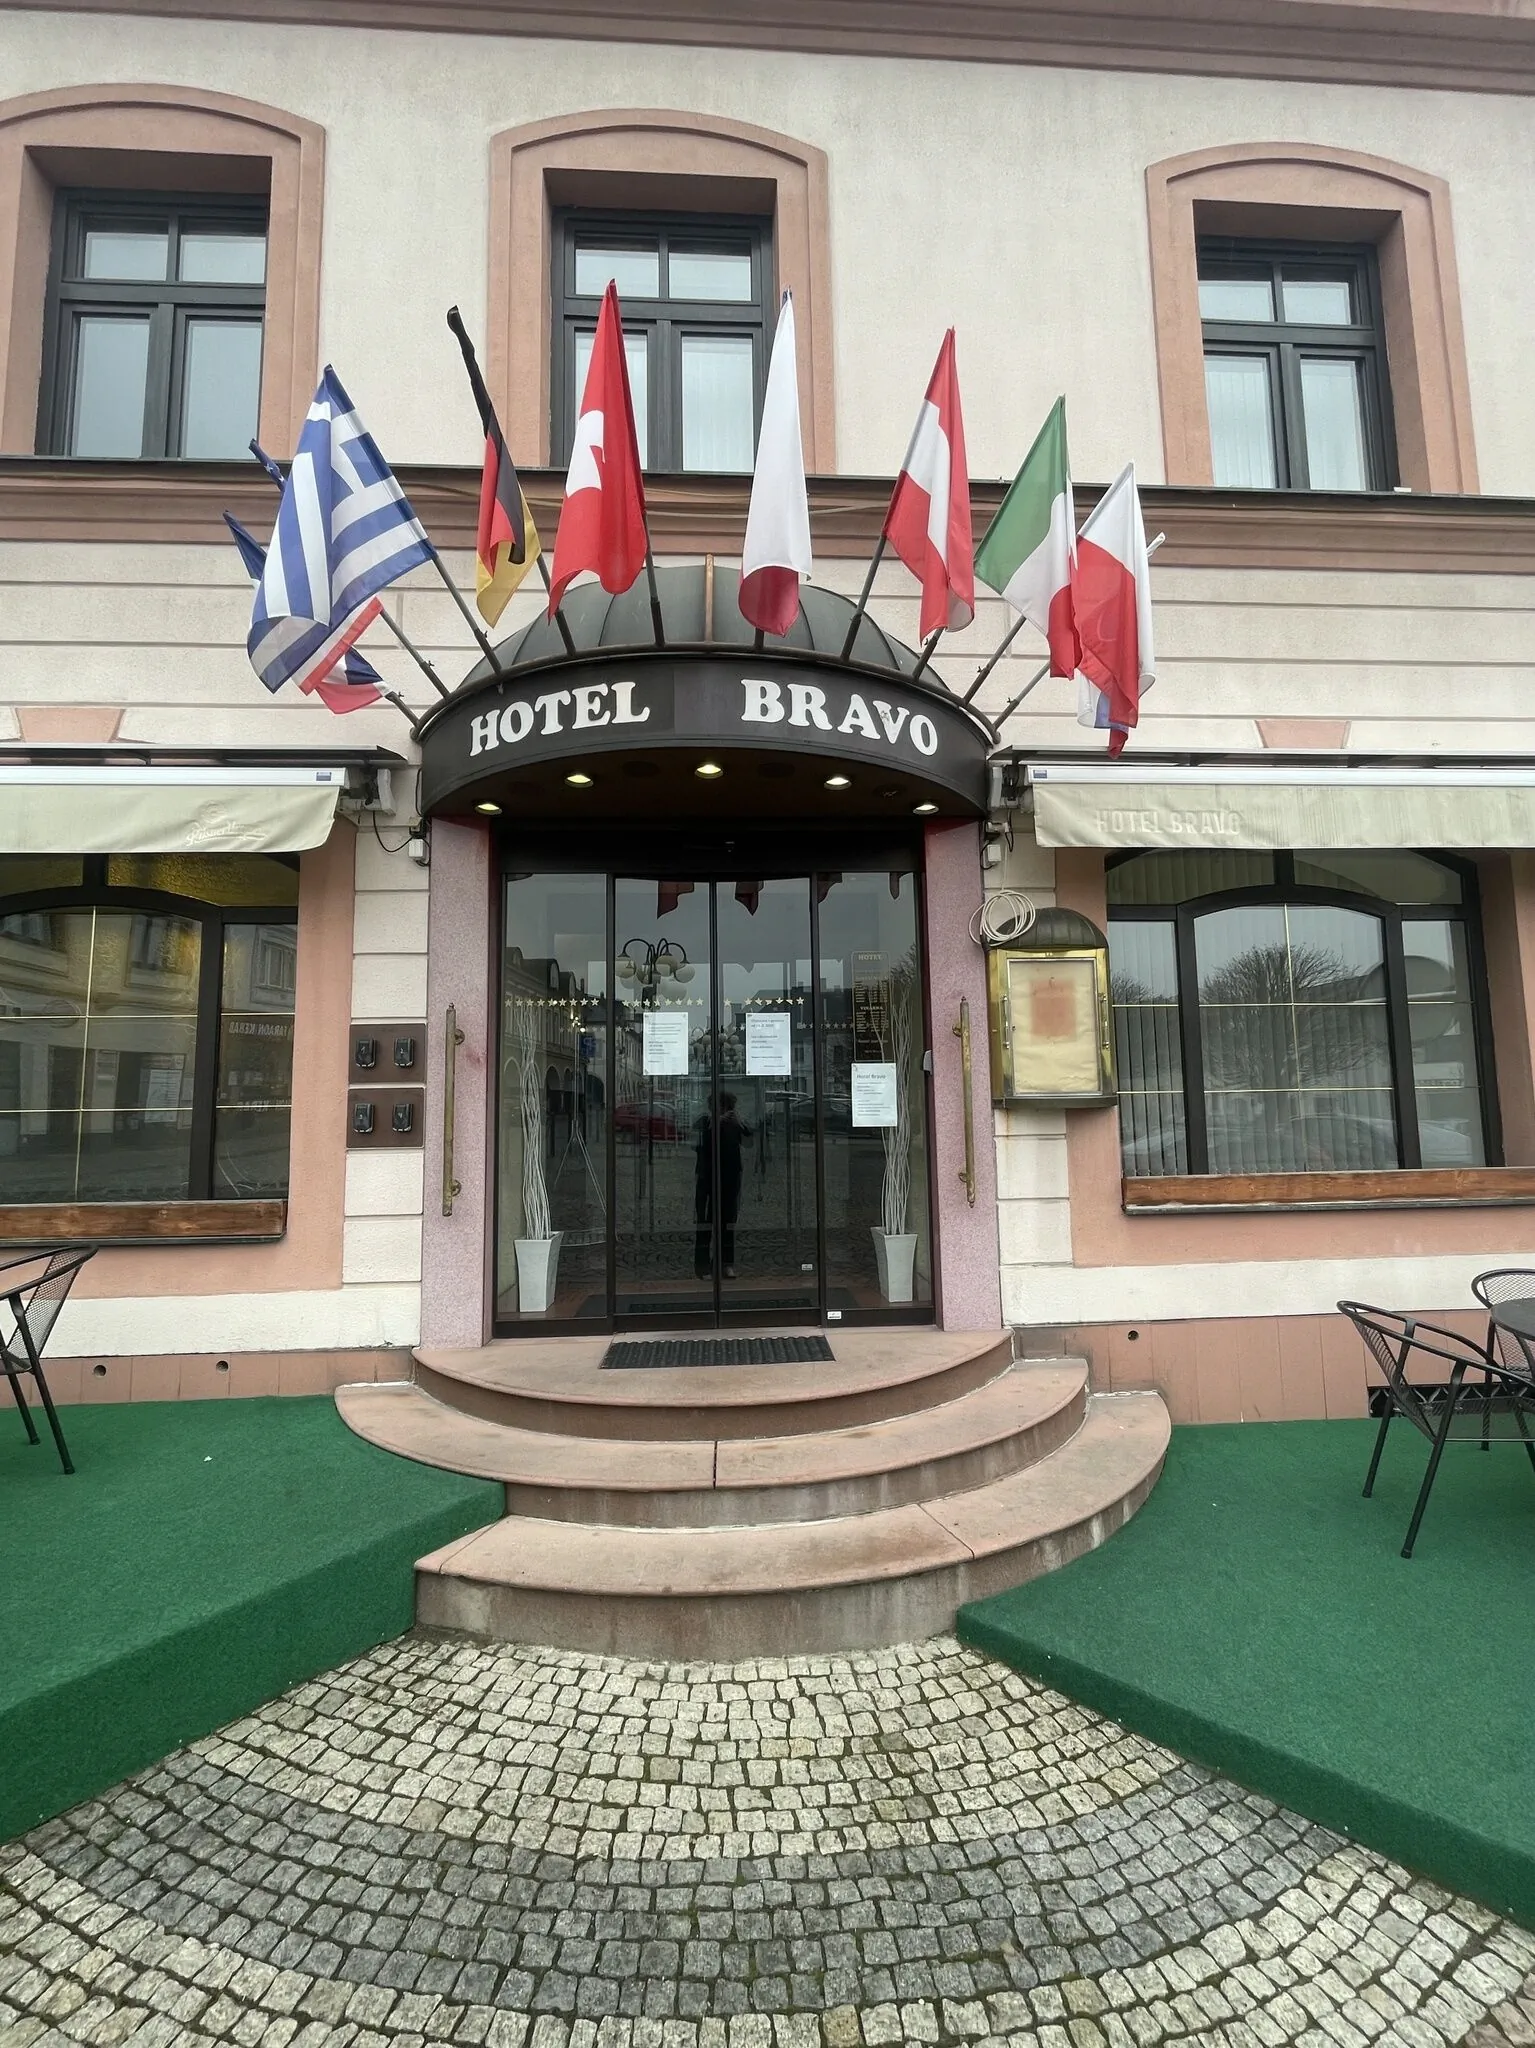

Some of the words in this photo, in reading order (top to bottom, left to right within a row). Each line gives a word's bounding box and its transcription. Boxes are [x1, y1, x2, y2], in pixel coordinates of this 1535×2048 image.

[469, 681, 651, 757] HOTEL
[740, 678, 938, 756] BRAVO
[1096, 810, 1163, 833] HOTEL
[1171, 810, 1241, 835] BRAVO
